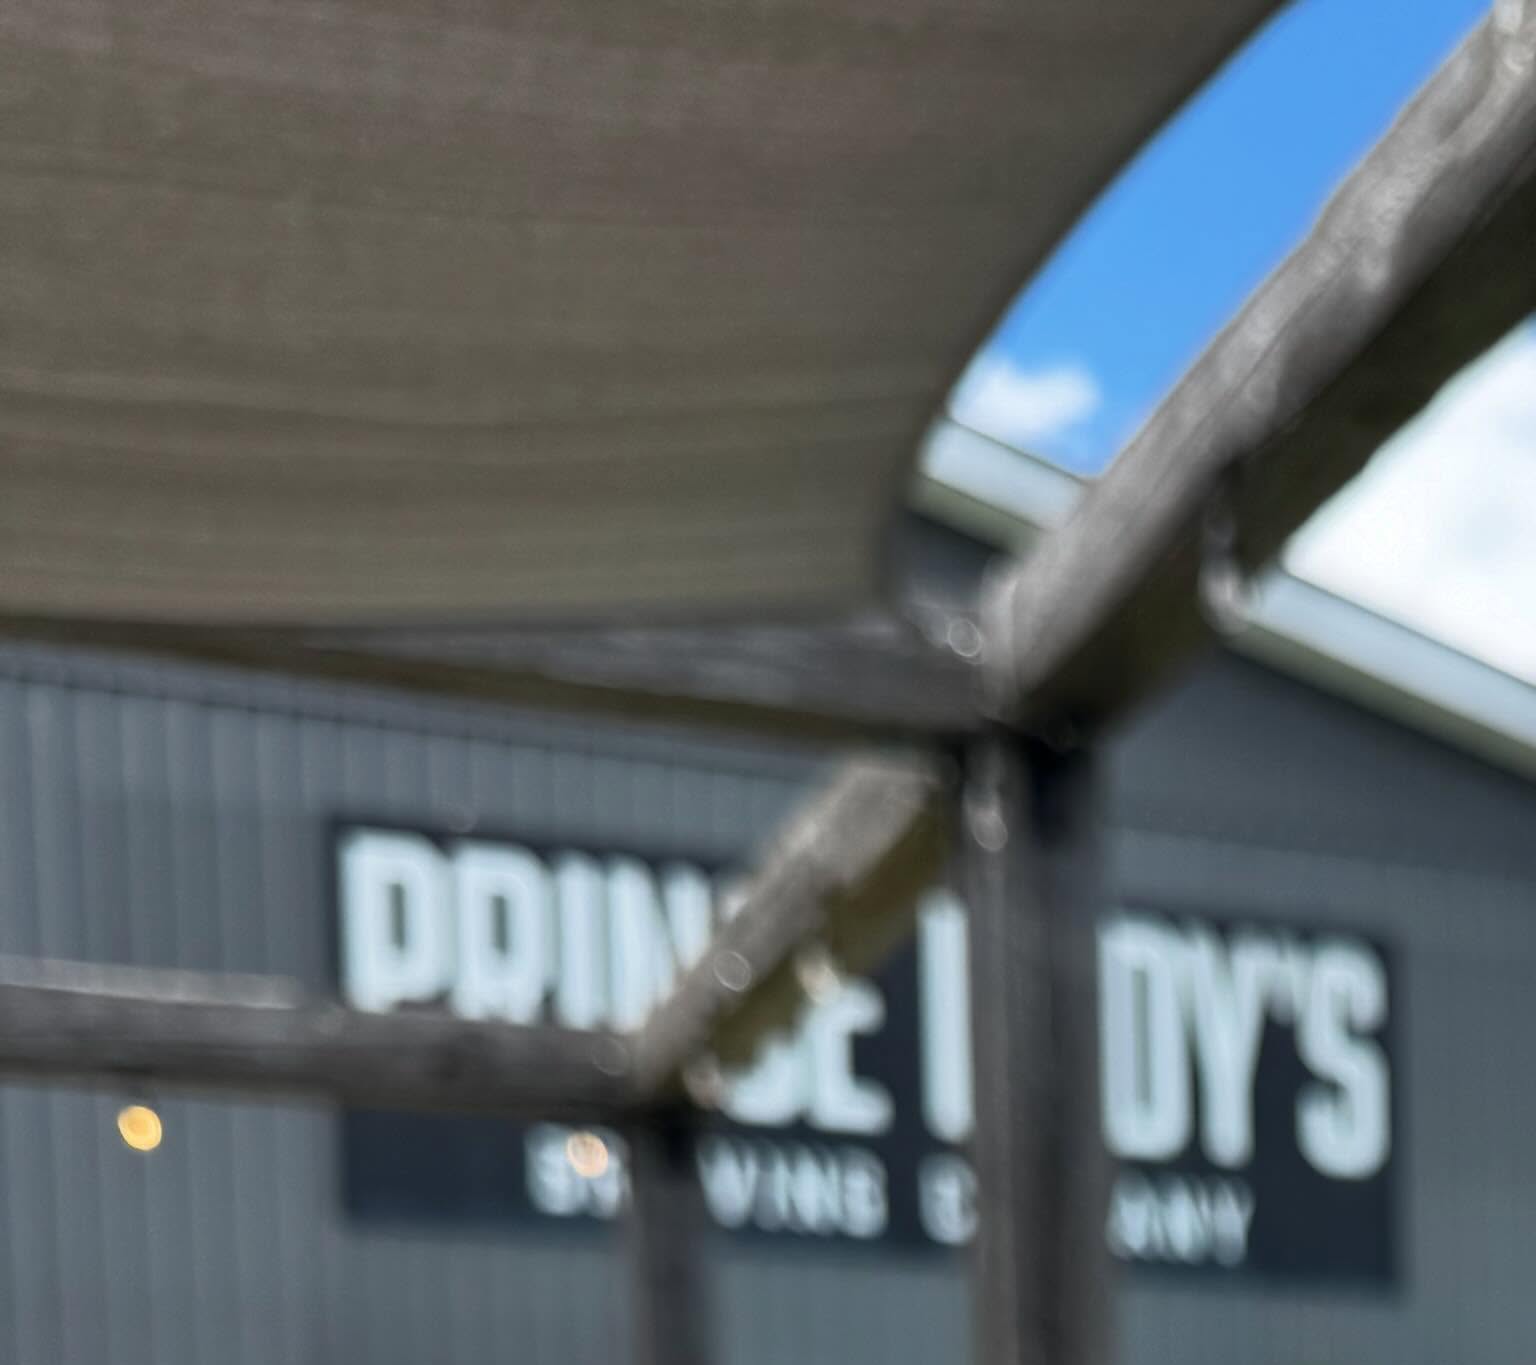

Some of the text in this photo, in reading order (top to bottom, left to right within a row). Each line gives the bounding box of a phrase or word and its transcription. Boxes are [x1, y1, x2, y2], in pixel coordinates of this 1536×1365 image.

[340, 826, 1393, 1180] PRINE DY'S
[524, 1122, 888, 1238] BRWING
